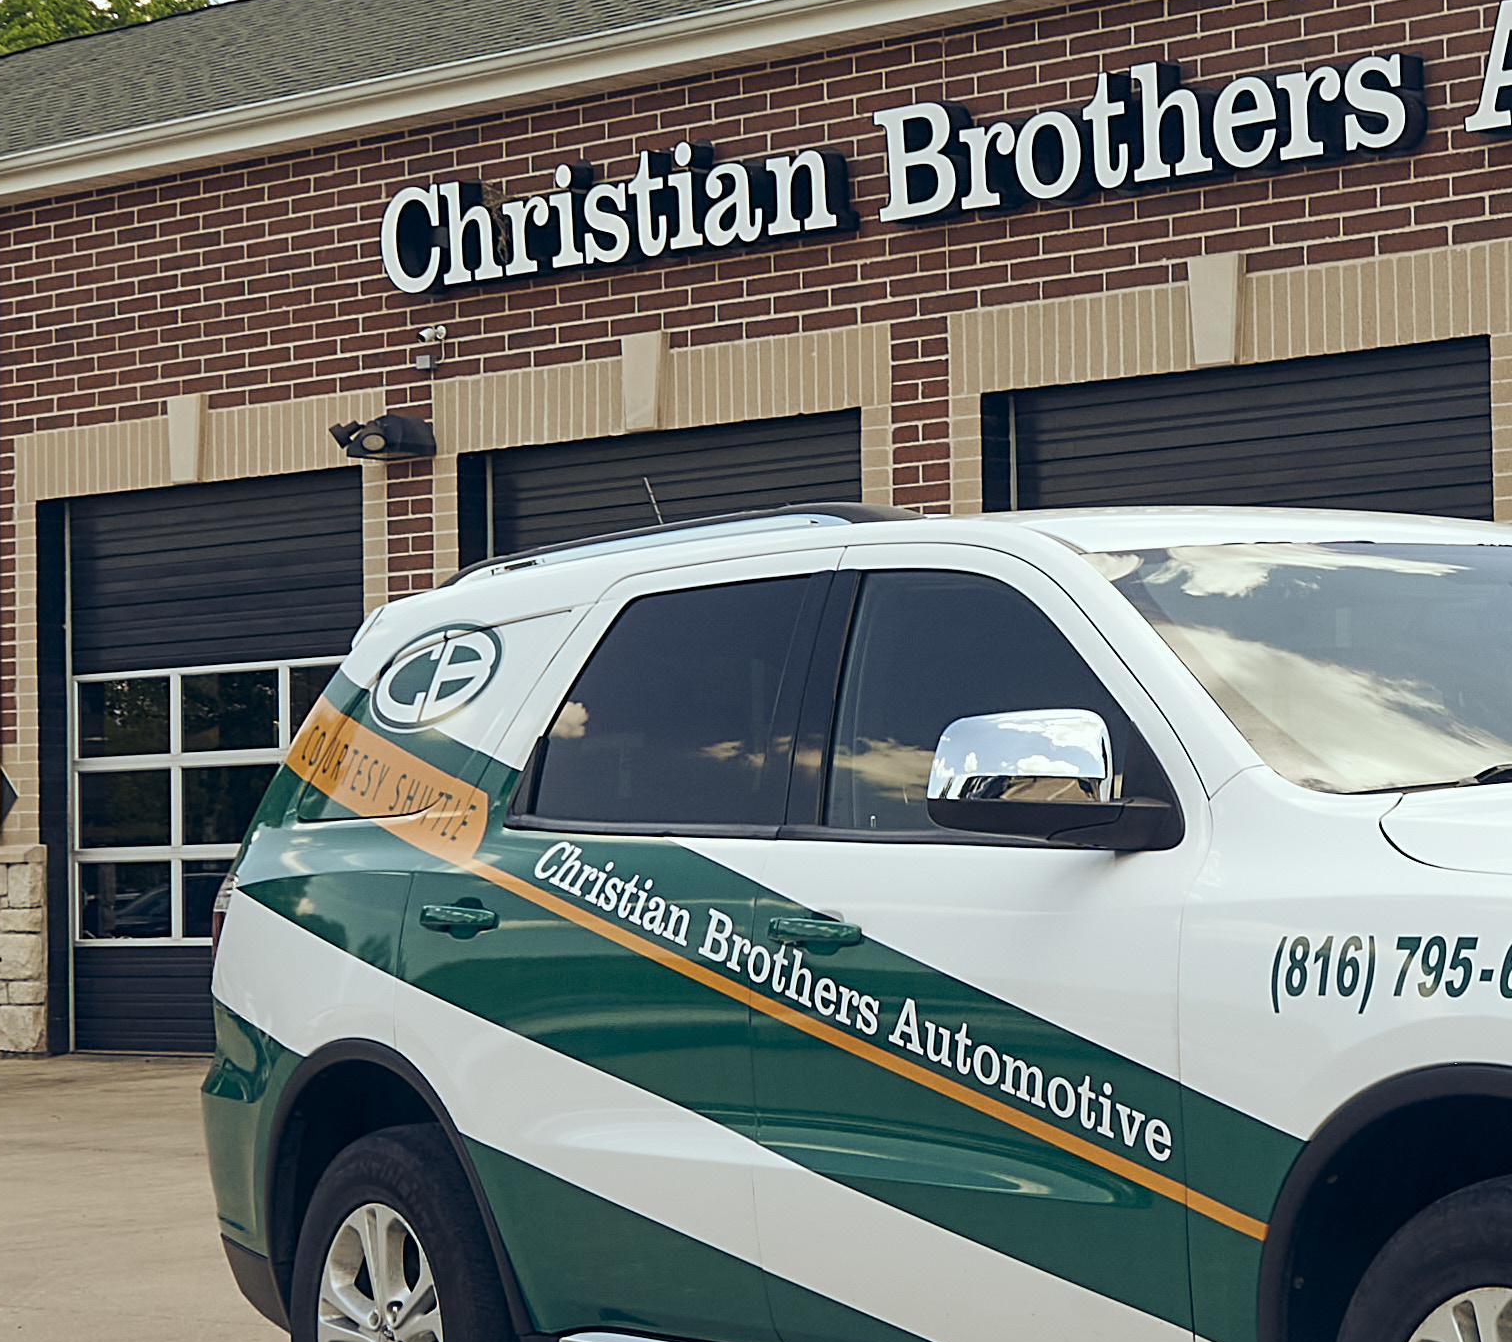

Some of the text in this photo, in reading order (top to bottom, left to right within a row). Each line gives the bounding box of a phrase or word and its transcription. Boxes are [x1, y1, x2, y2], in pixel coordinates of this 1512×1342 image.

[380, 140, 838, 294] Christian
[872, 53, 1407, 222] Brothers
[301, 725, 477, 842] COURTESY SHUTTLE
[533, 841, 1173, 1162] Christian Brothers Automotive
[1271, 935, 1376, 1015] (816)
